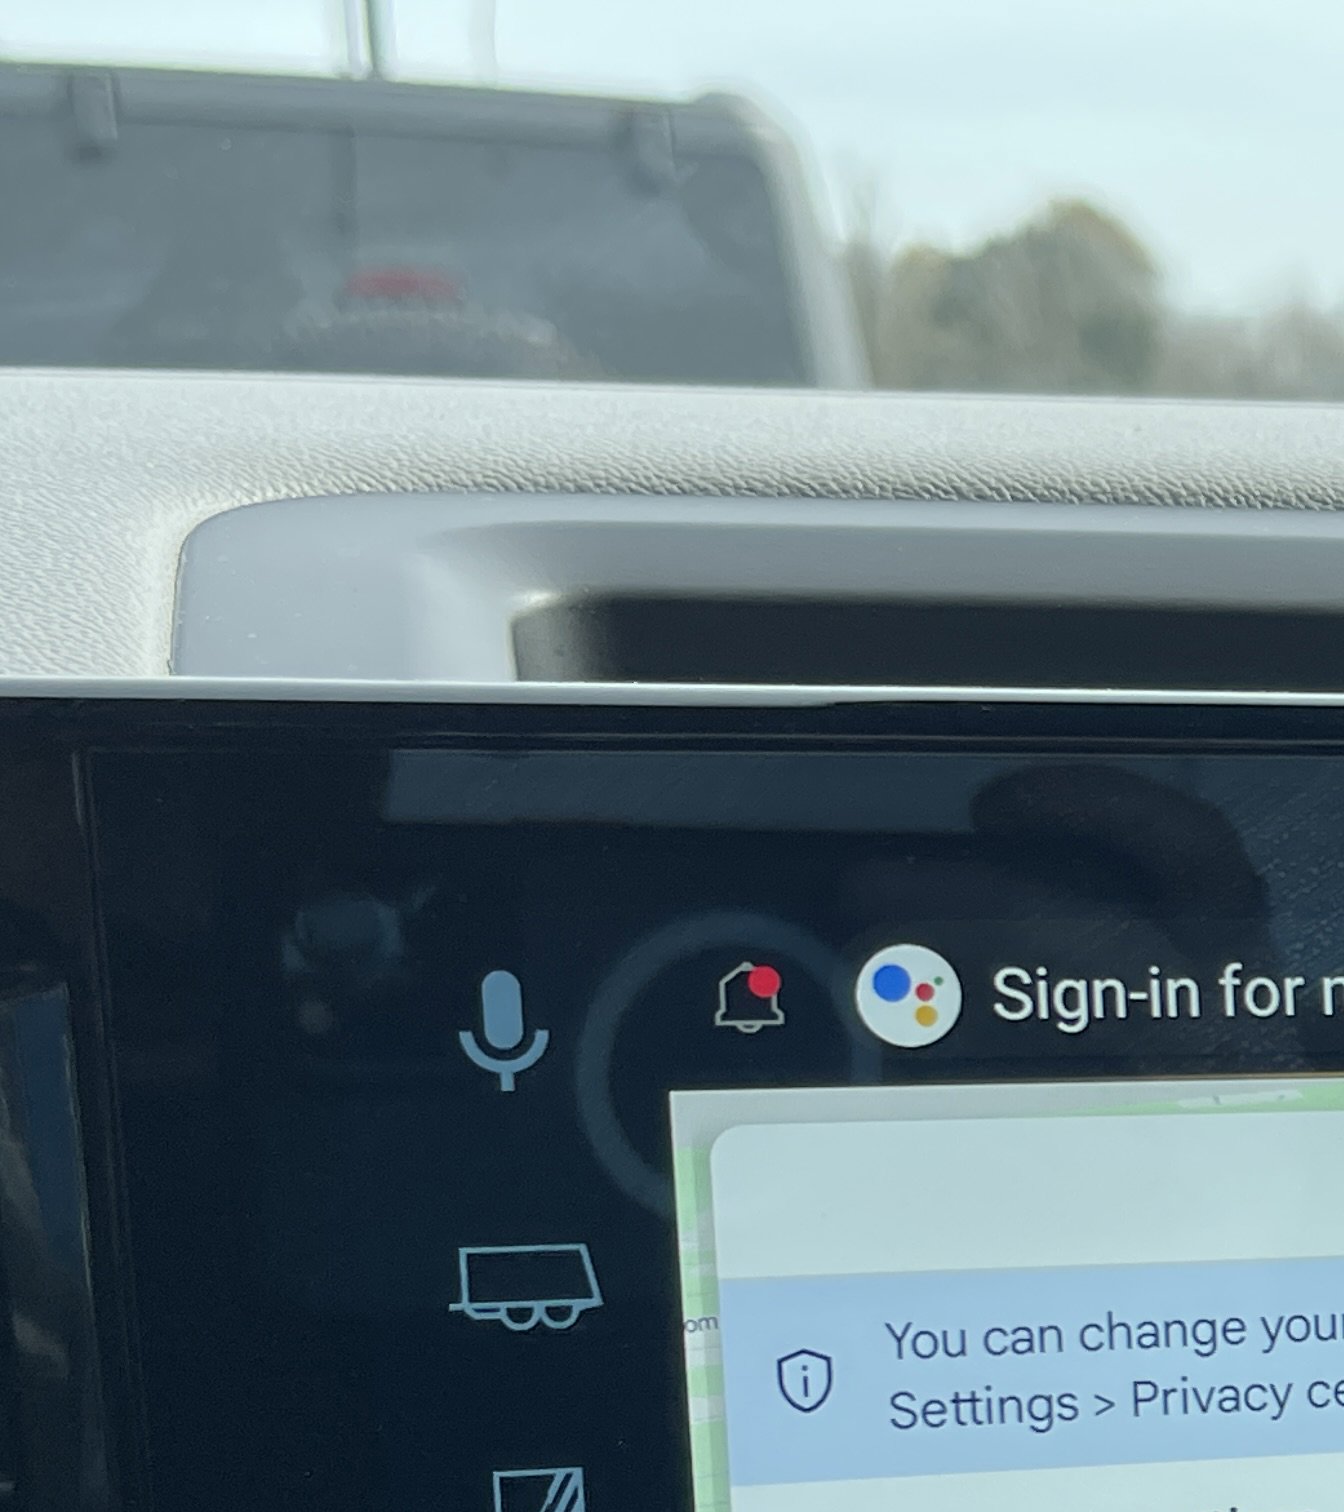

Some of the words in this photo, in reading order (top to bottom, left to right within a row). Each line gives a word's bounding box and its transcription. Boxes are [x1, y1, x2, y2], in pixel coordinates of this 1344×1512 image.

[993, 966, 1200, 1033] Sign-in
[1219, 963, 1304, 1018] for
[886, 1320, 968, 1360] You
[982, 1320, 1064, 1357] can
[1079, 1310, 1248, 1357] change
[890, 1386, 1080, 1435] Settings
[1094, 1392, 1116, 1418] >
[1132, 1372, 1293, 1421] Privacy
